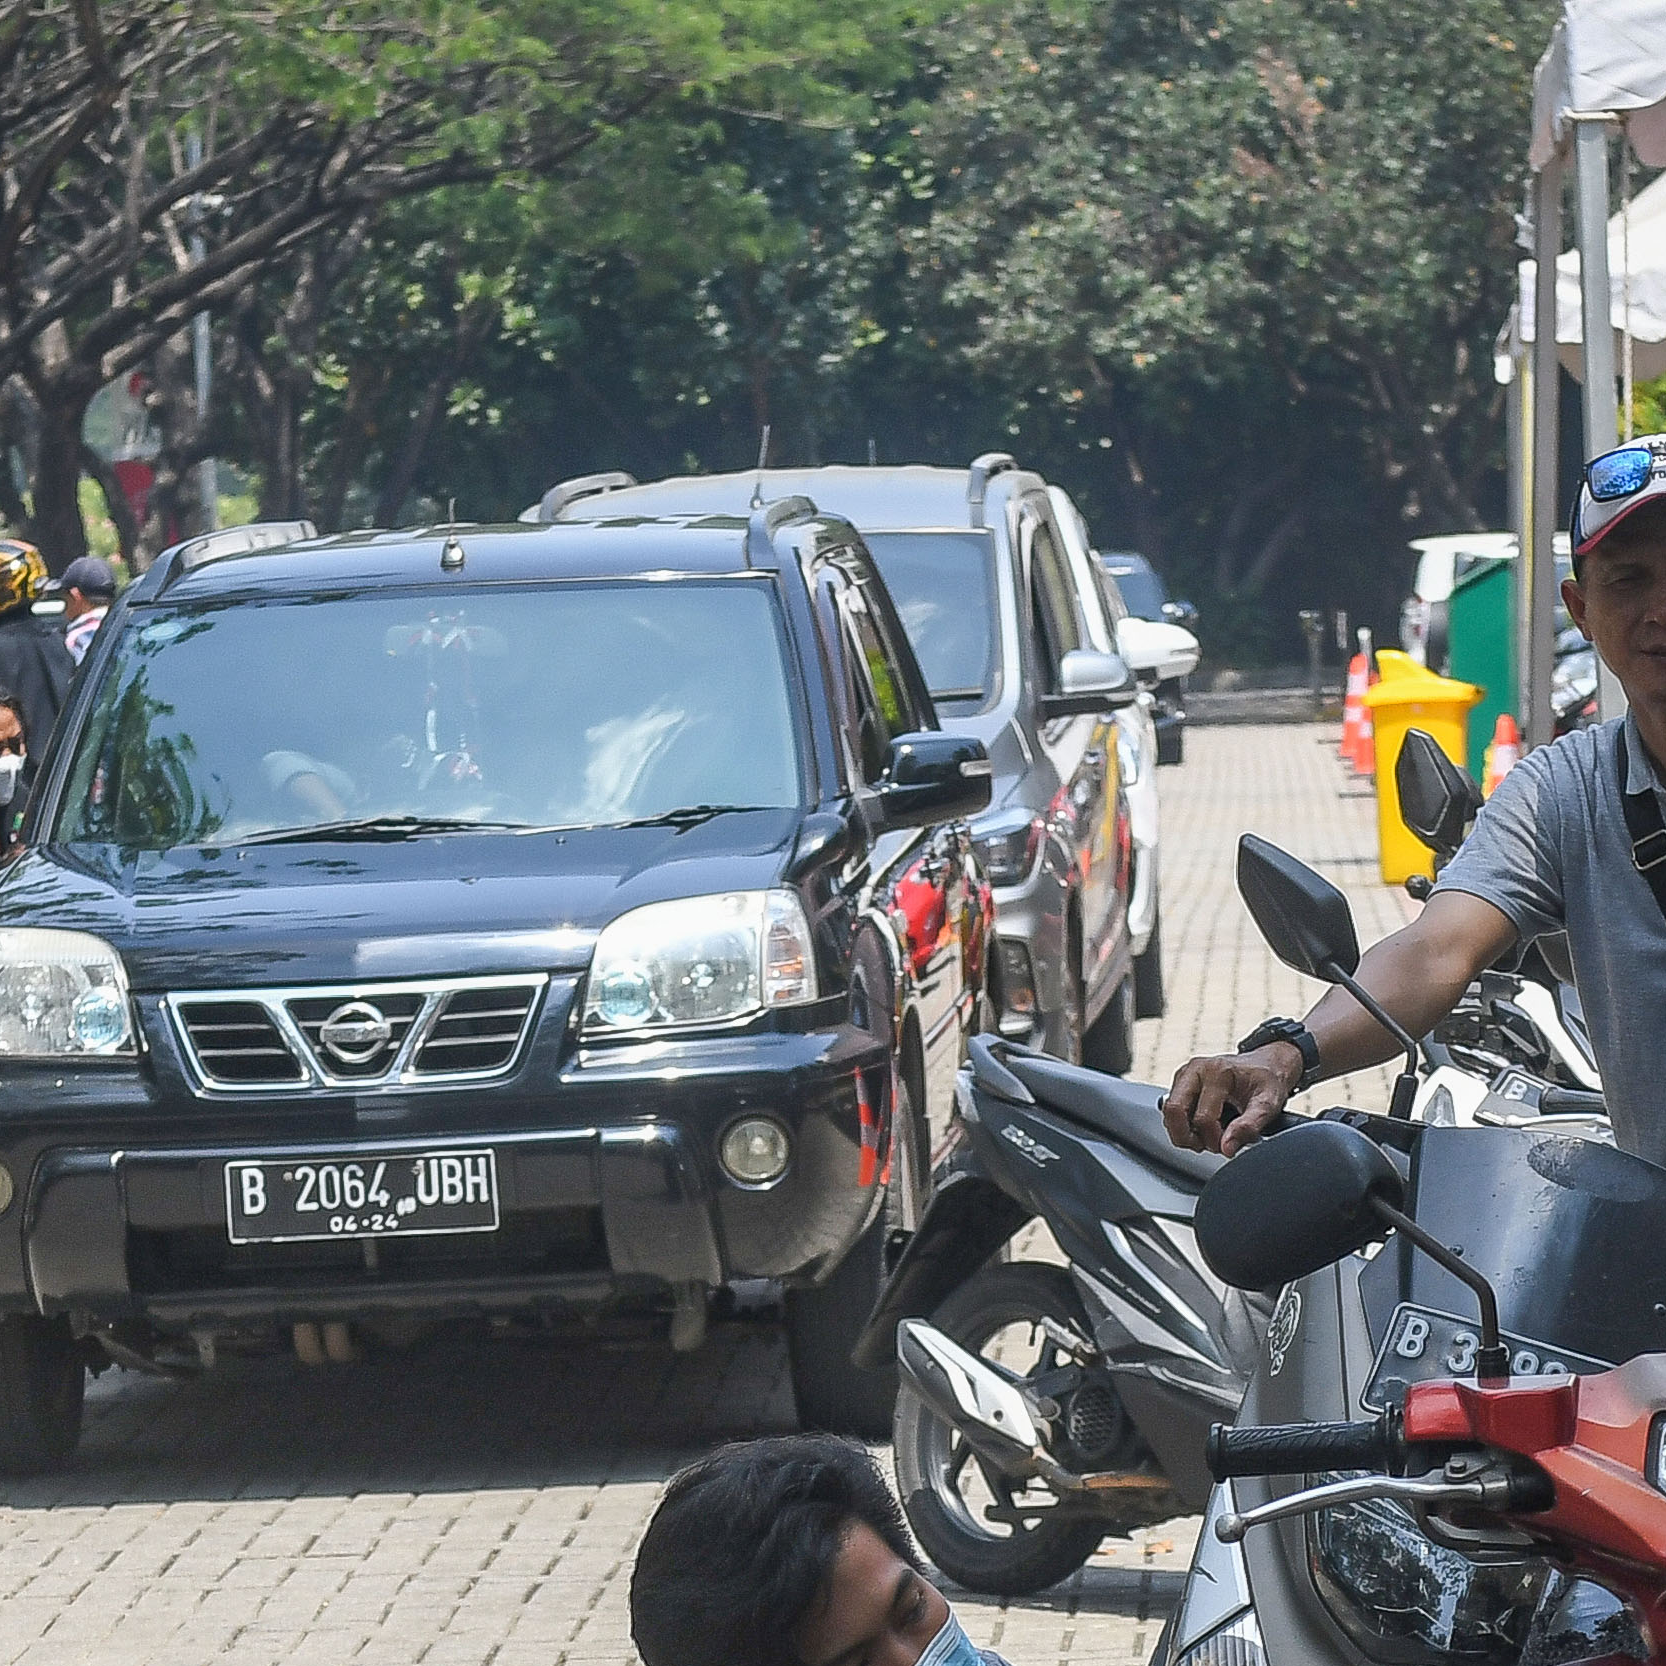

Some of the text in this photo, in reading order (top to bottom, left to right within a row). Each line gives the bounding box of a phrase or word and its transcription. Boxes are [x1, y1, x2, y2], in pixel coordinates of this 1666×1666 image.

[1503, 1079, 1529, 1101] B
[240, 1156, 490, 1215] B 2064 UBH
[1396, 1316, 1430, 1359] B
